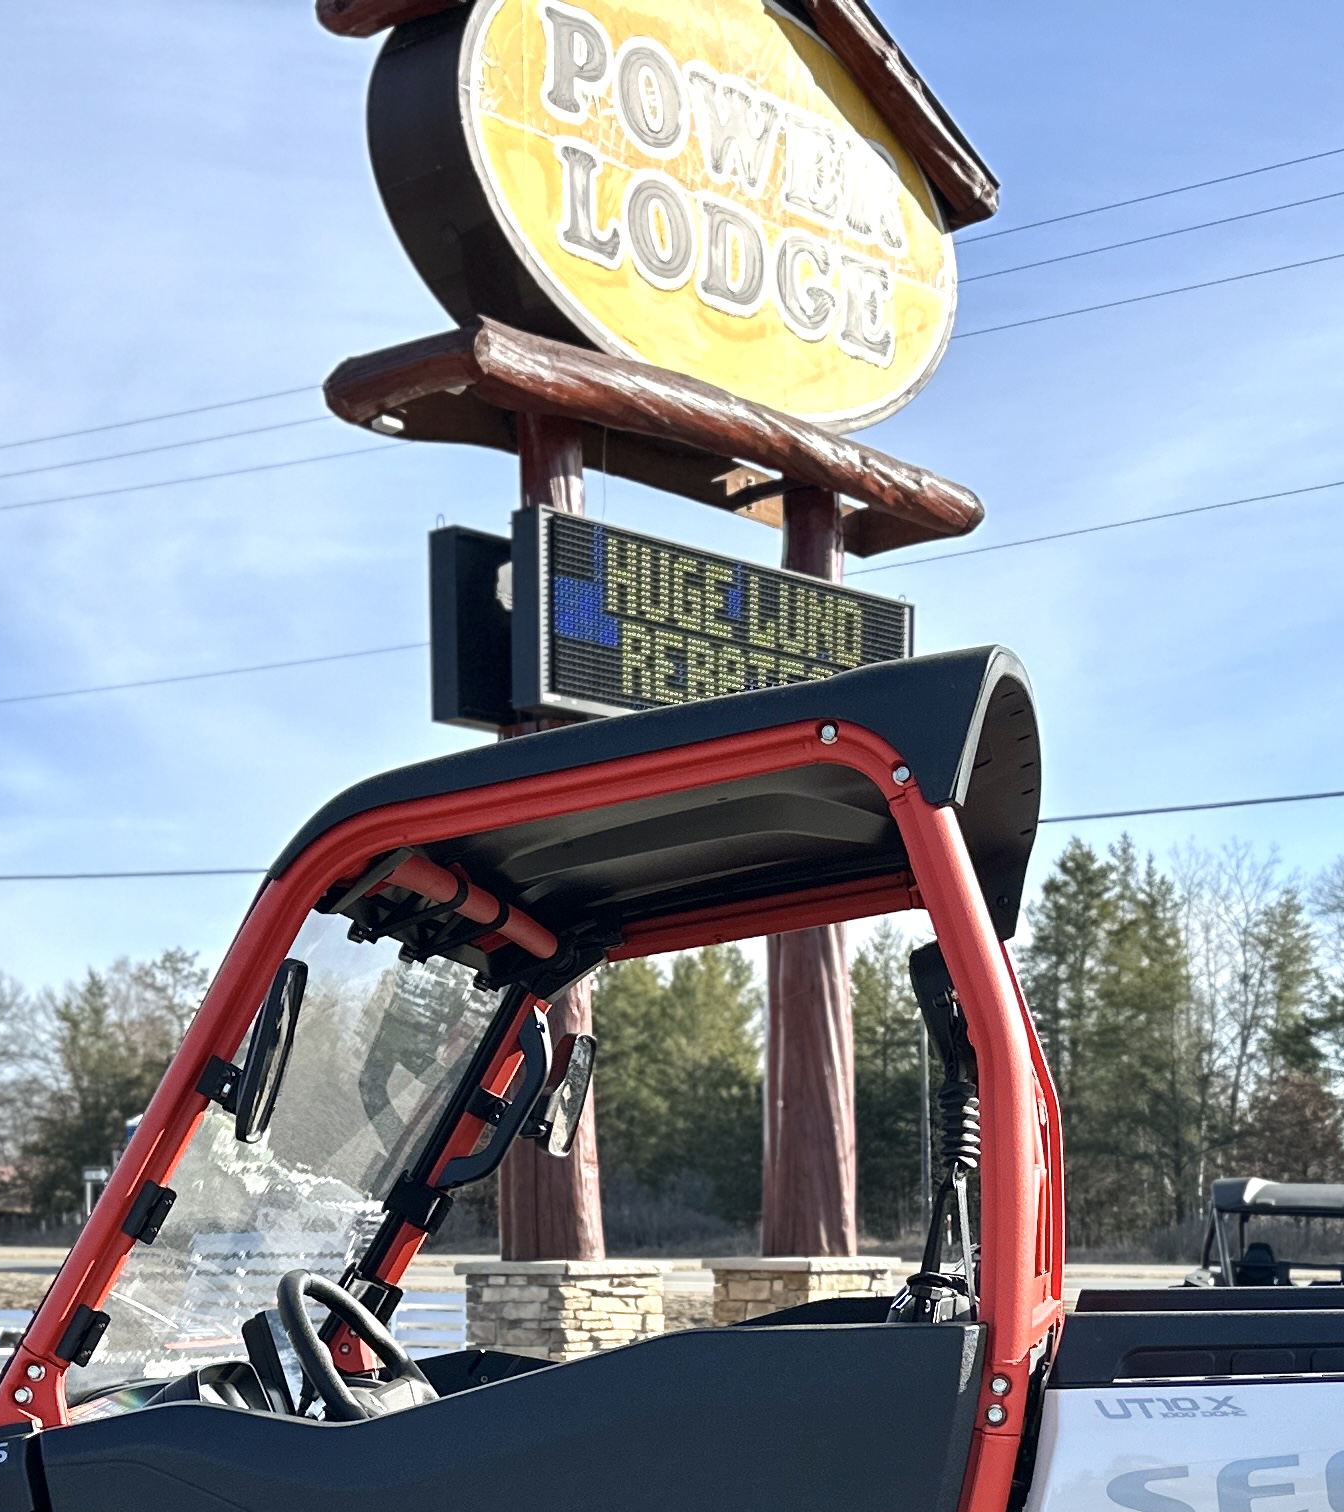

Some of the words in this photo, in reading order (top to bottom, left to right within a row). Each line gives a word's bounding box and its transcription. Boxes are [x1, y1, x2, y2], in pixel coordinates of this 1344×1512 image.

[544, 5, 904, 249] POWER
[560, 145, 892, 357] LODGE
[607, 537, 734, 638] HUGE
[749, 575, 863, 667] LUND
[1158, 1411, 1197, 1419] 1000
